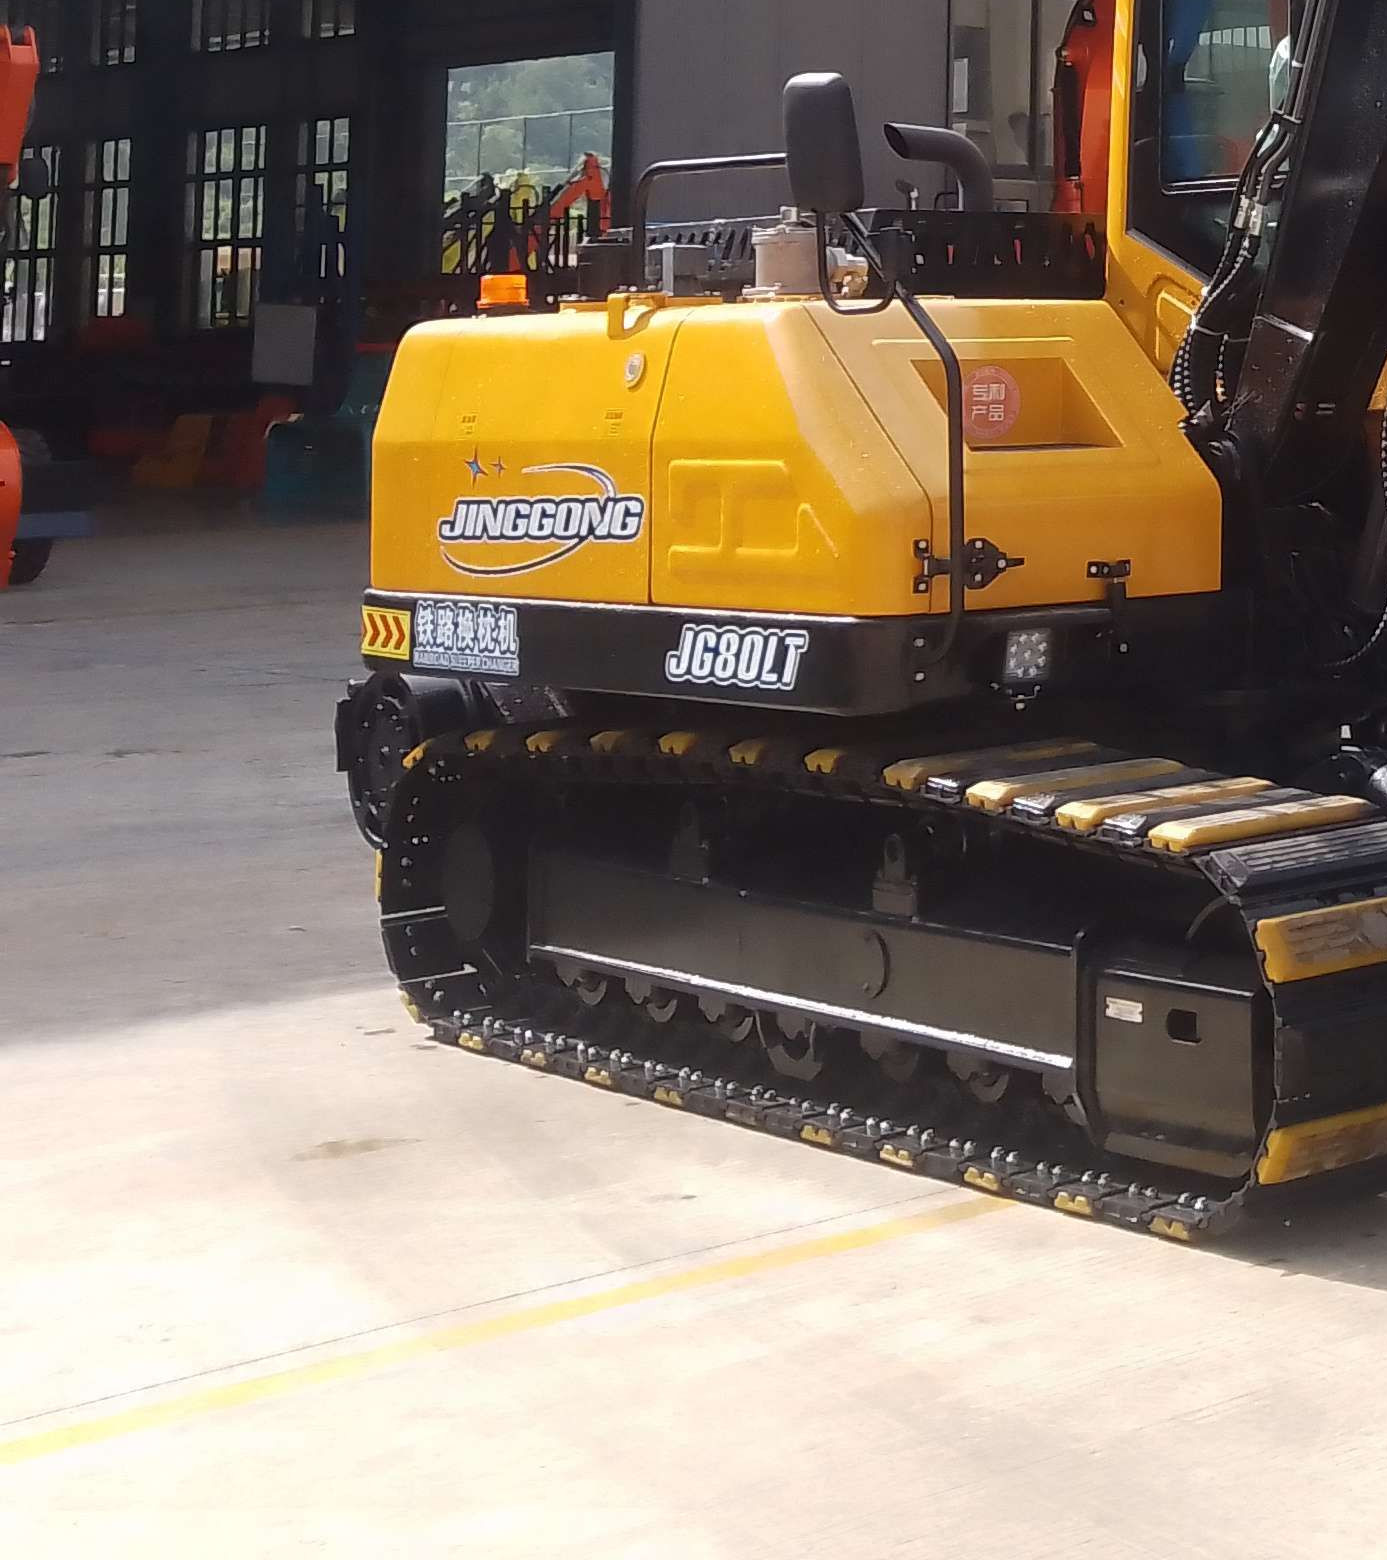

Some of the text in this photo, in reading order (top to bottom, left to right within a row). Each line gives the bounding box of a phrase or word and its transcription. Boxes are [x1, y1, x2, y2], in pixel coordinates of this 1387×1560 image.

[971, 382, 1006, 401] 专利
[970, 403, 1005, 422] 产品
[439, 498, 643, 539] JINGGONG
[416, 604, 517, 653] 铁路换枕机
[667, 627, 807, 687] JG80LT
